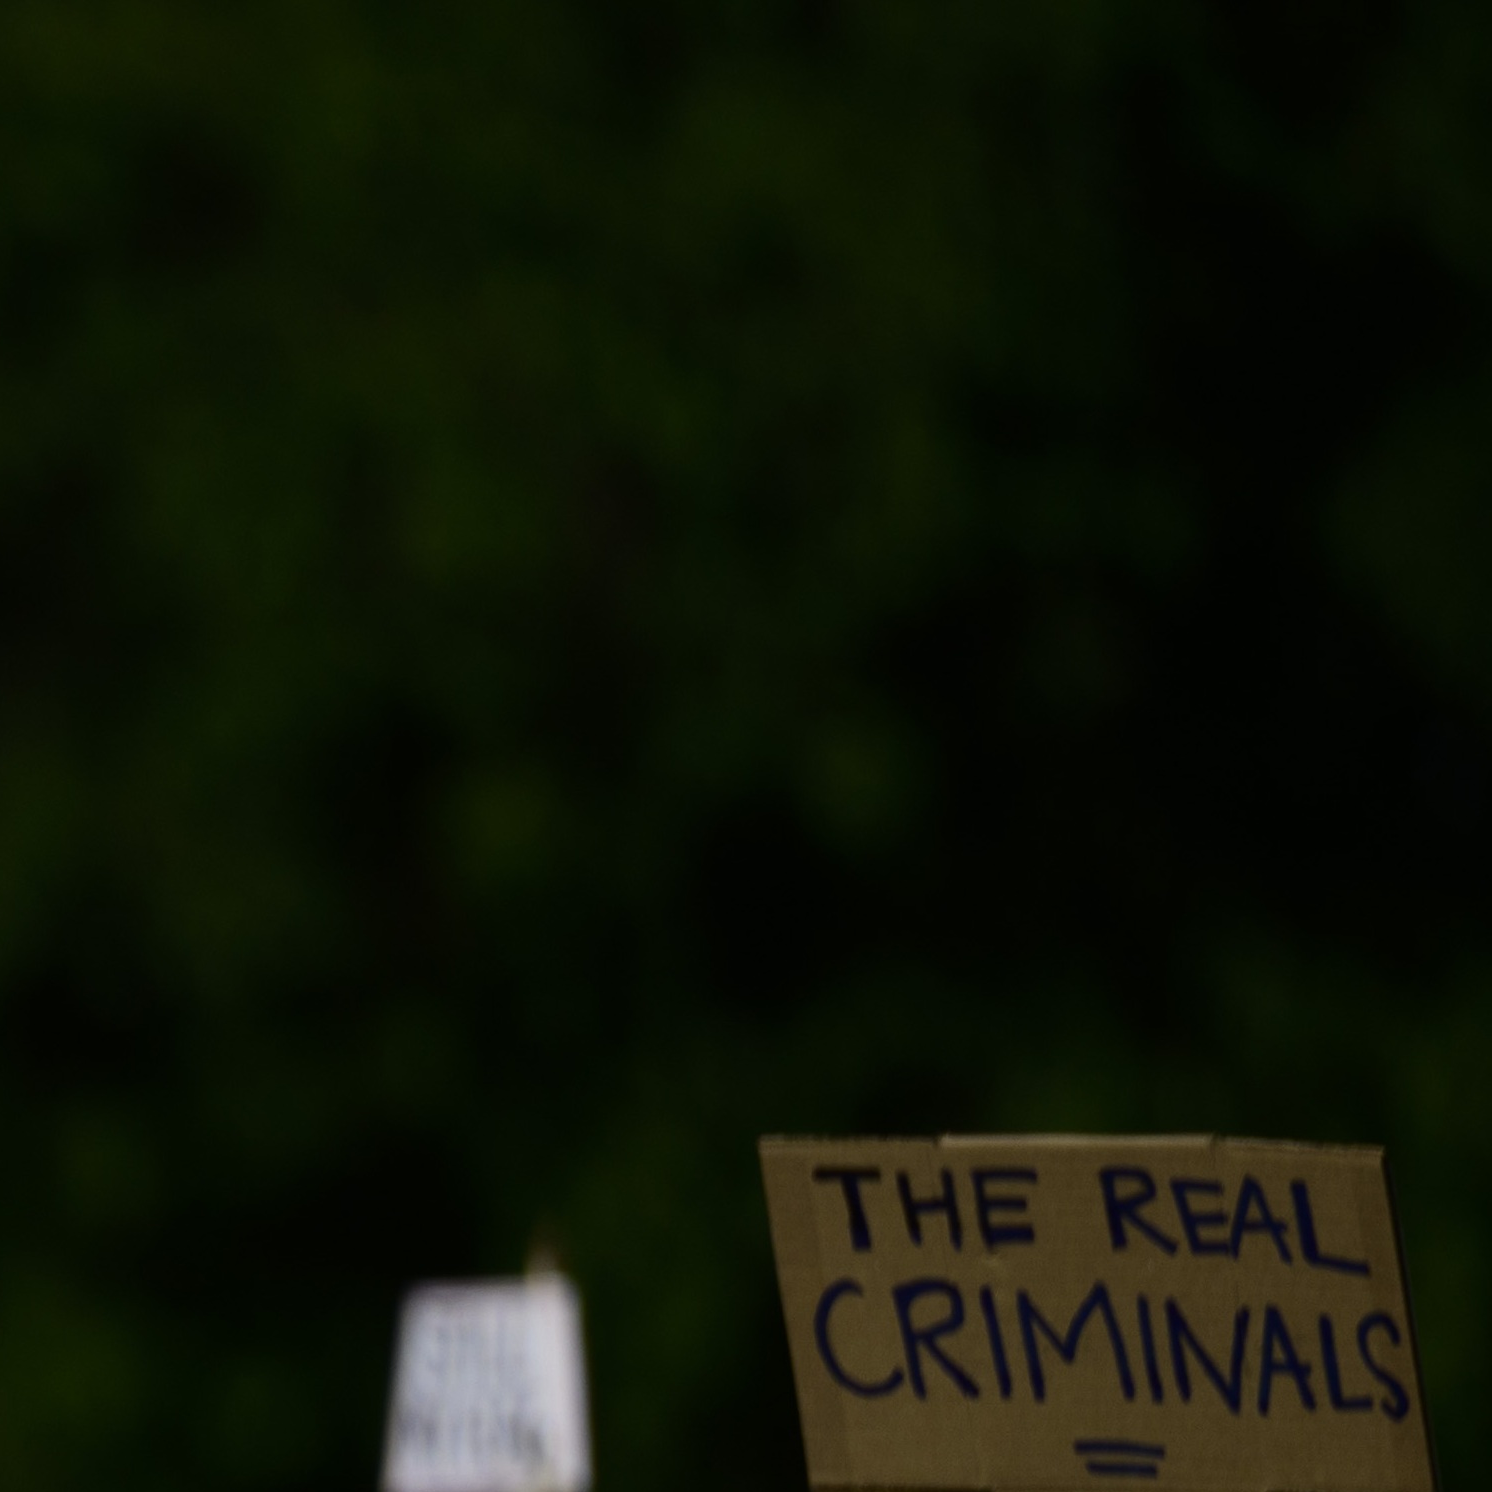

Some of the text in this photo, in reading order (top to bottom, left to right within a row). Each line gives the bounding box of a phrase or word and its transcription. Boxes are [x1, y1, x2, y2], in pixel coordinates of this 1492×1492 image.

[814, 1167, 1371, 1277] THE REAL
[814, 1278, 1409, 1422] CRIMINALS
